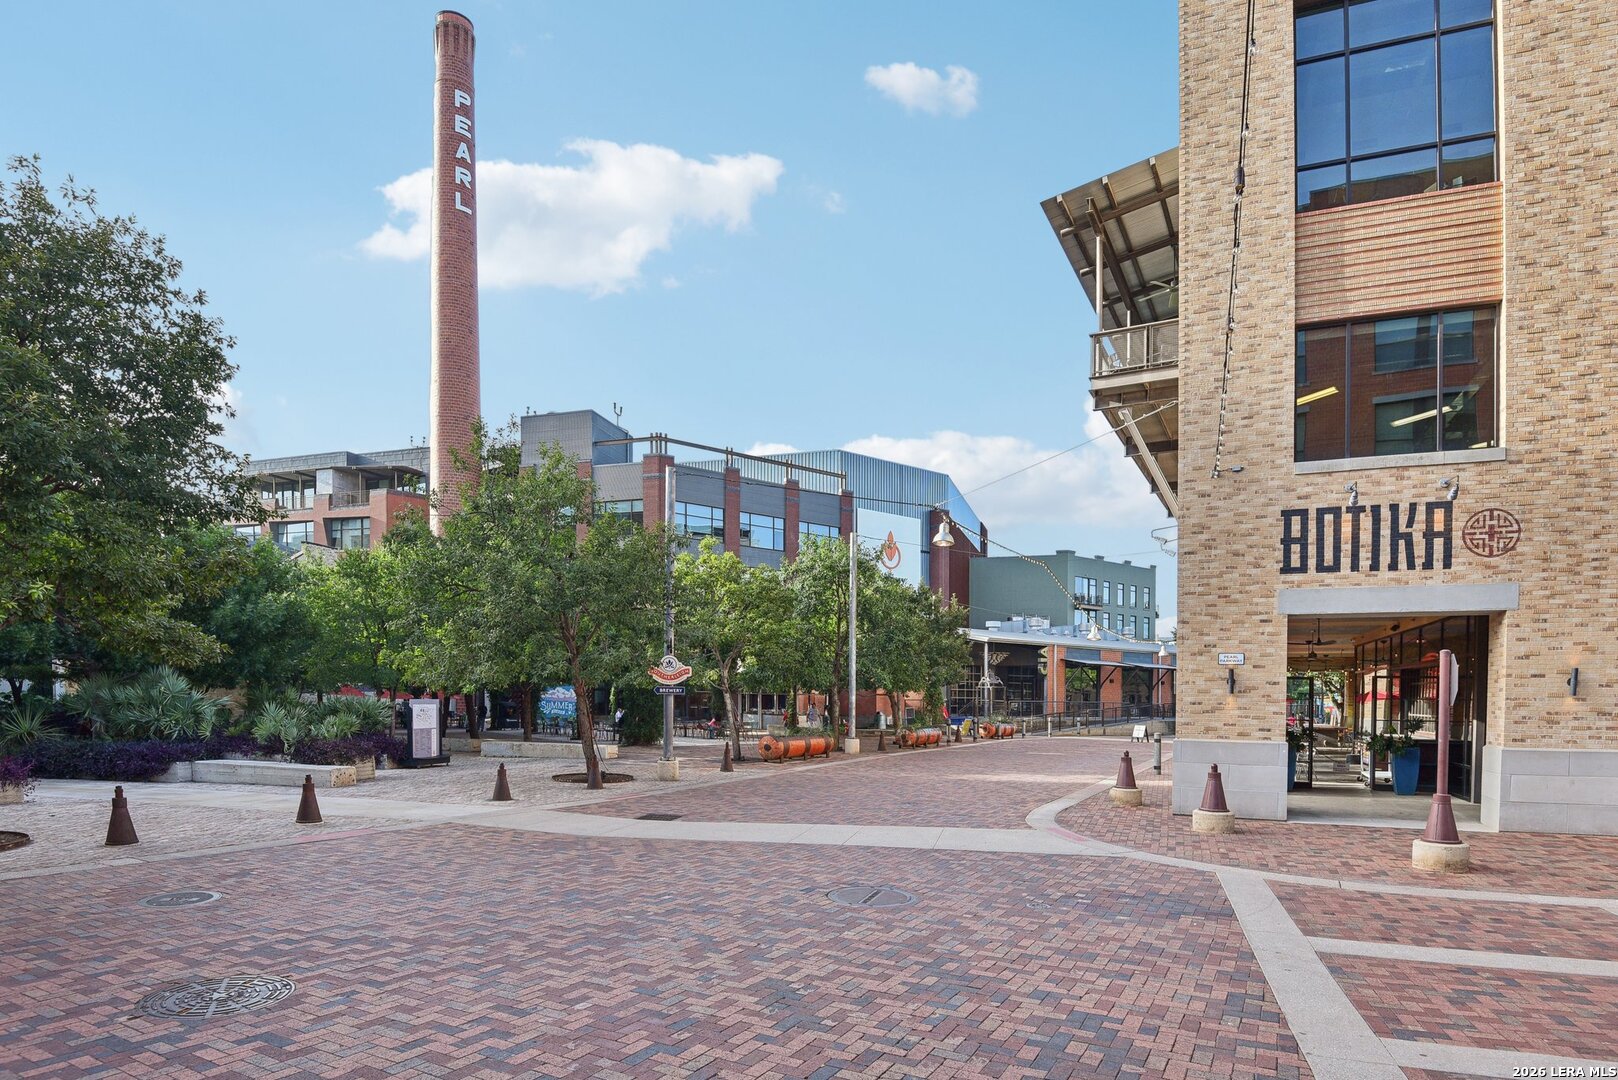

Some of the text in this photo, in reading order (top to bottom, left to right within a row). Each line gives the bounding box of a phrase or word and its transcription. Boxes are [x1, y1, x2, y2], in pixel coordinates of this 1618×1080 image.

[454, 89, 472, 215] PEARL
[1280, 501, 1454, 574] BOTIKA
[540, 701, 573, 711] SUMMER
